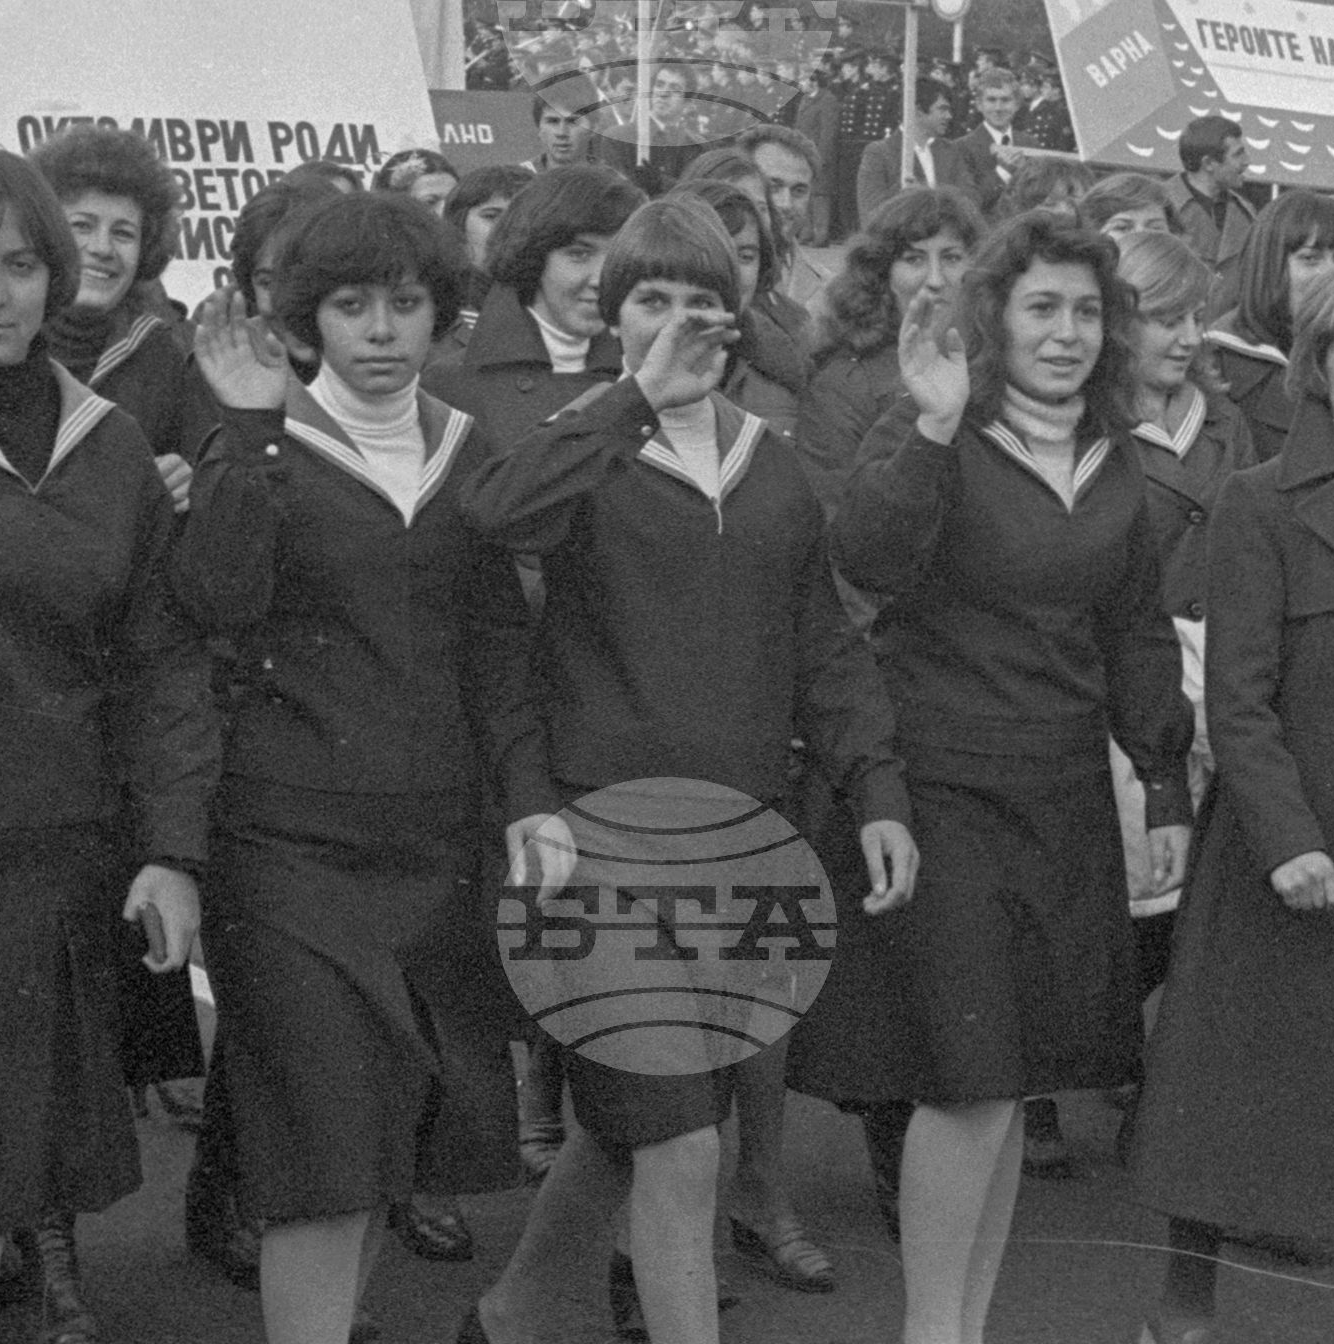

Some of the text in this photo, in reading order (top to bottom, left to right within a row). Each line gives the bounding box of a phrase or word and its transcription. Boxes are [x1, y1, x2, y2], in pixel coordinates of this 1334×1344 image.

[1085, 30, 1154, 88] ВАРНА
[1196, 18, 1304, 62] ГЕРОИТЕ
[17, 115, 382, 165] ОМВРИ РОДИ
